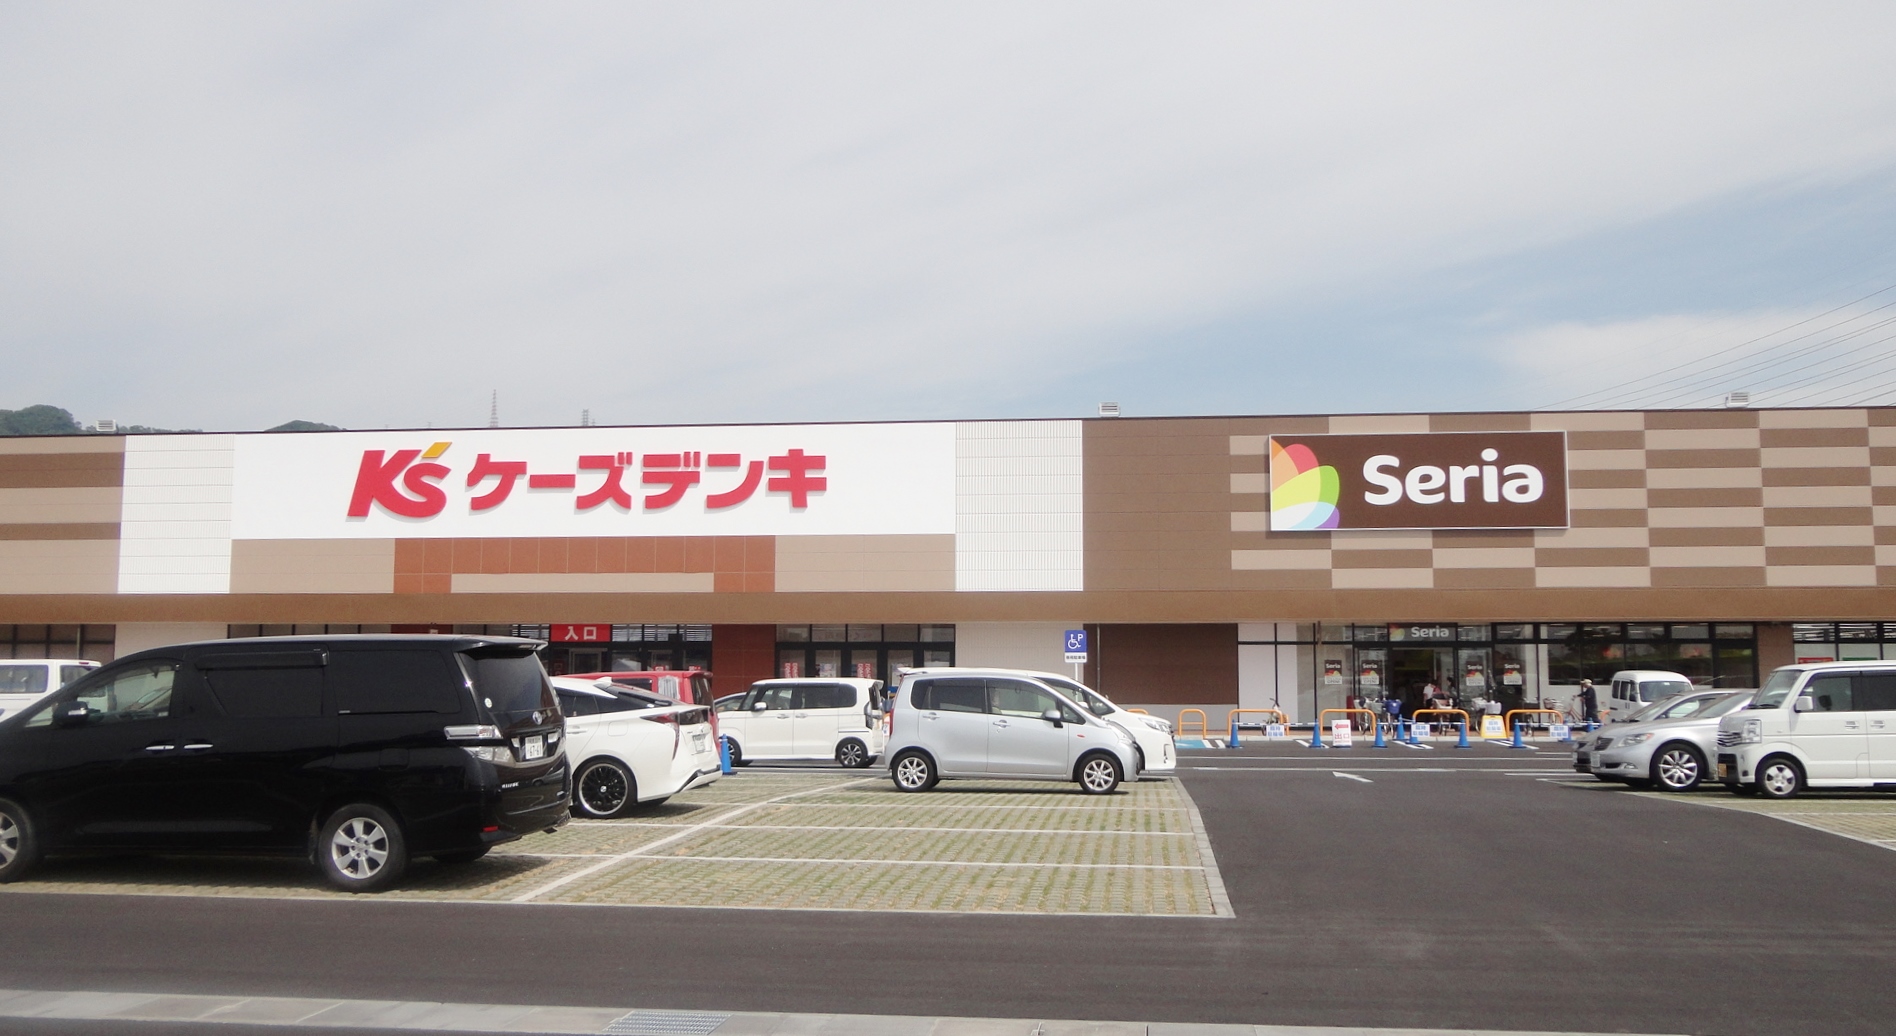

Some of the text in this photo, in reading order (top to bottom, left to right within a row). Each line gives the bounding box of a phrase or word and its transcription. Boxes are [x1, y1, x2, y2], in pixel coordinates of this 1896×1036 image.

[347, 441, 828, 519] K's ケーズデンキ
[1362, 447, 1545, 506] Seria
[564, 625, 597, 641] 入口
[1078, 634, 1084, 642] P
[1411, 625, 1449, 638] Seria
